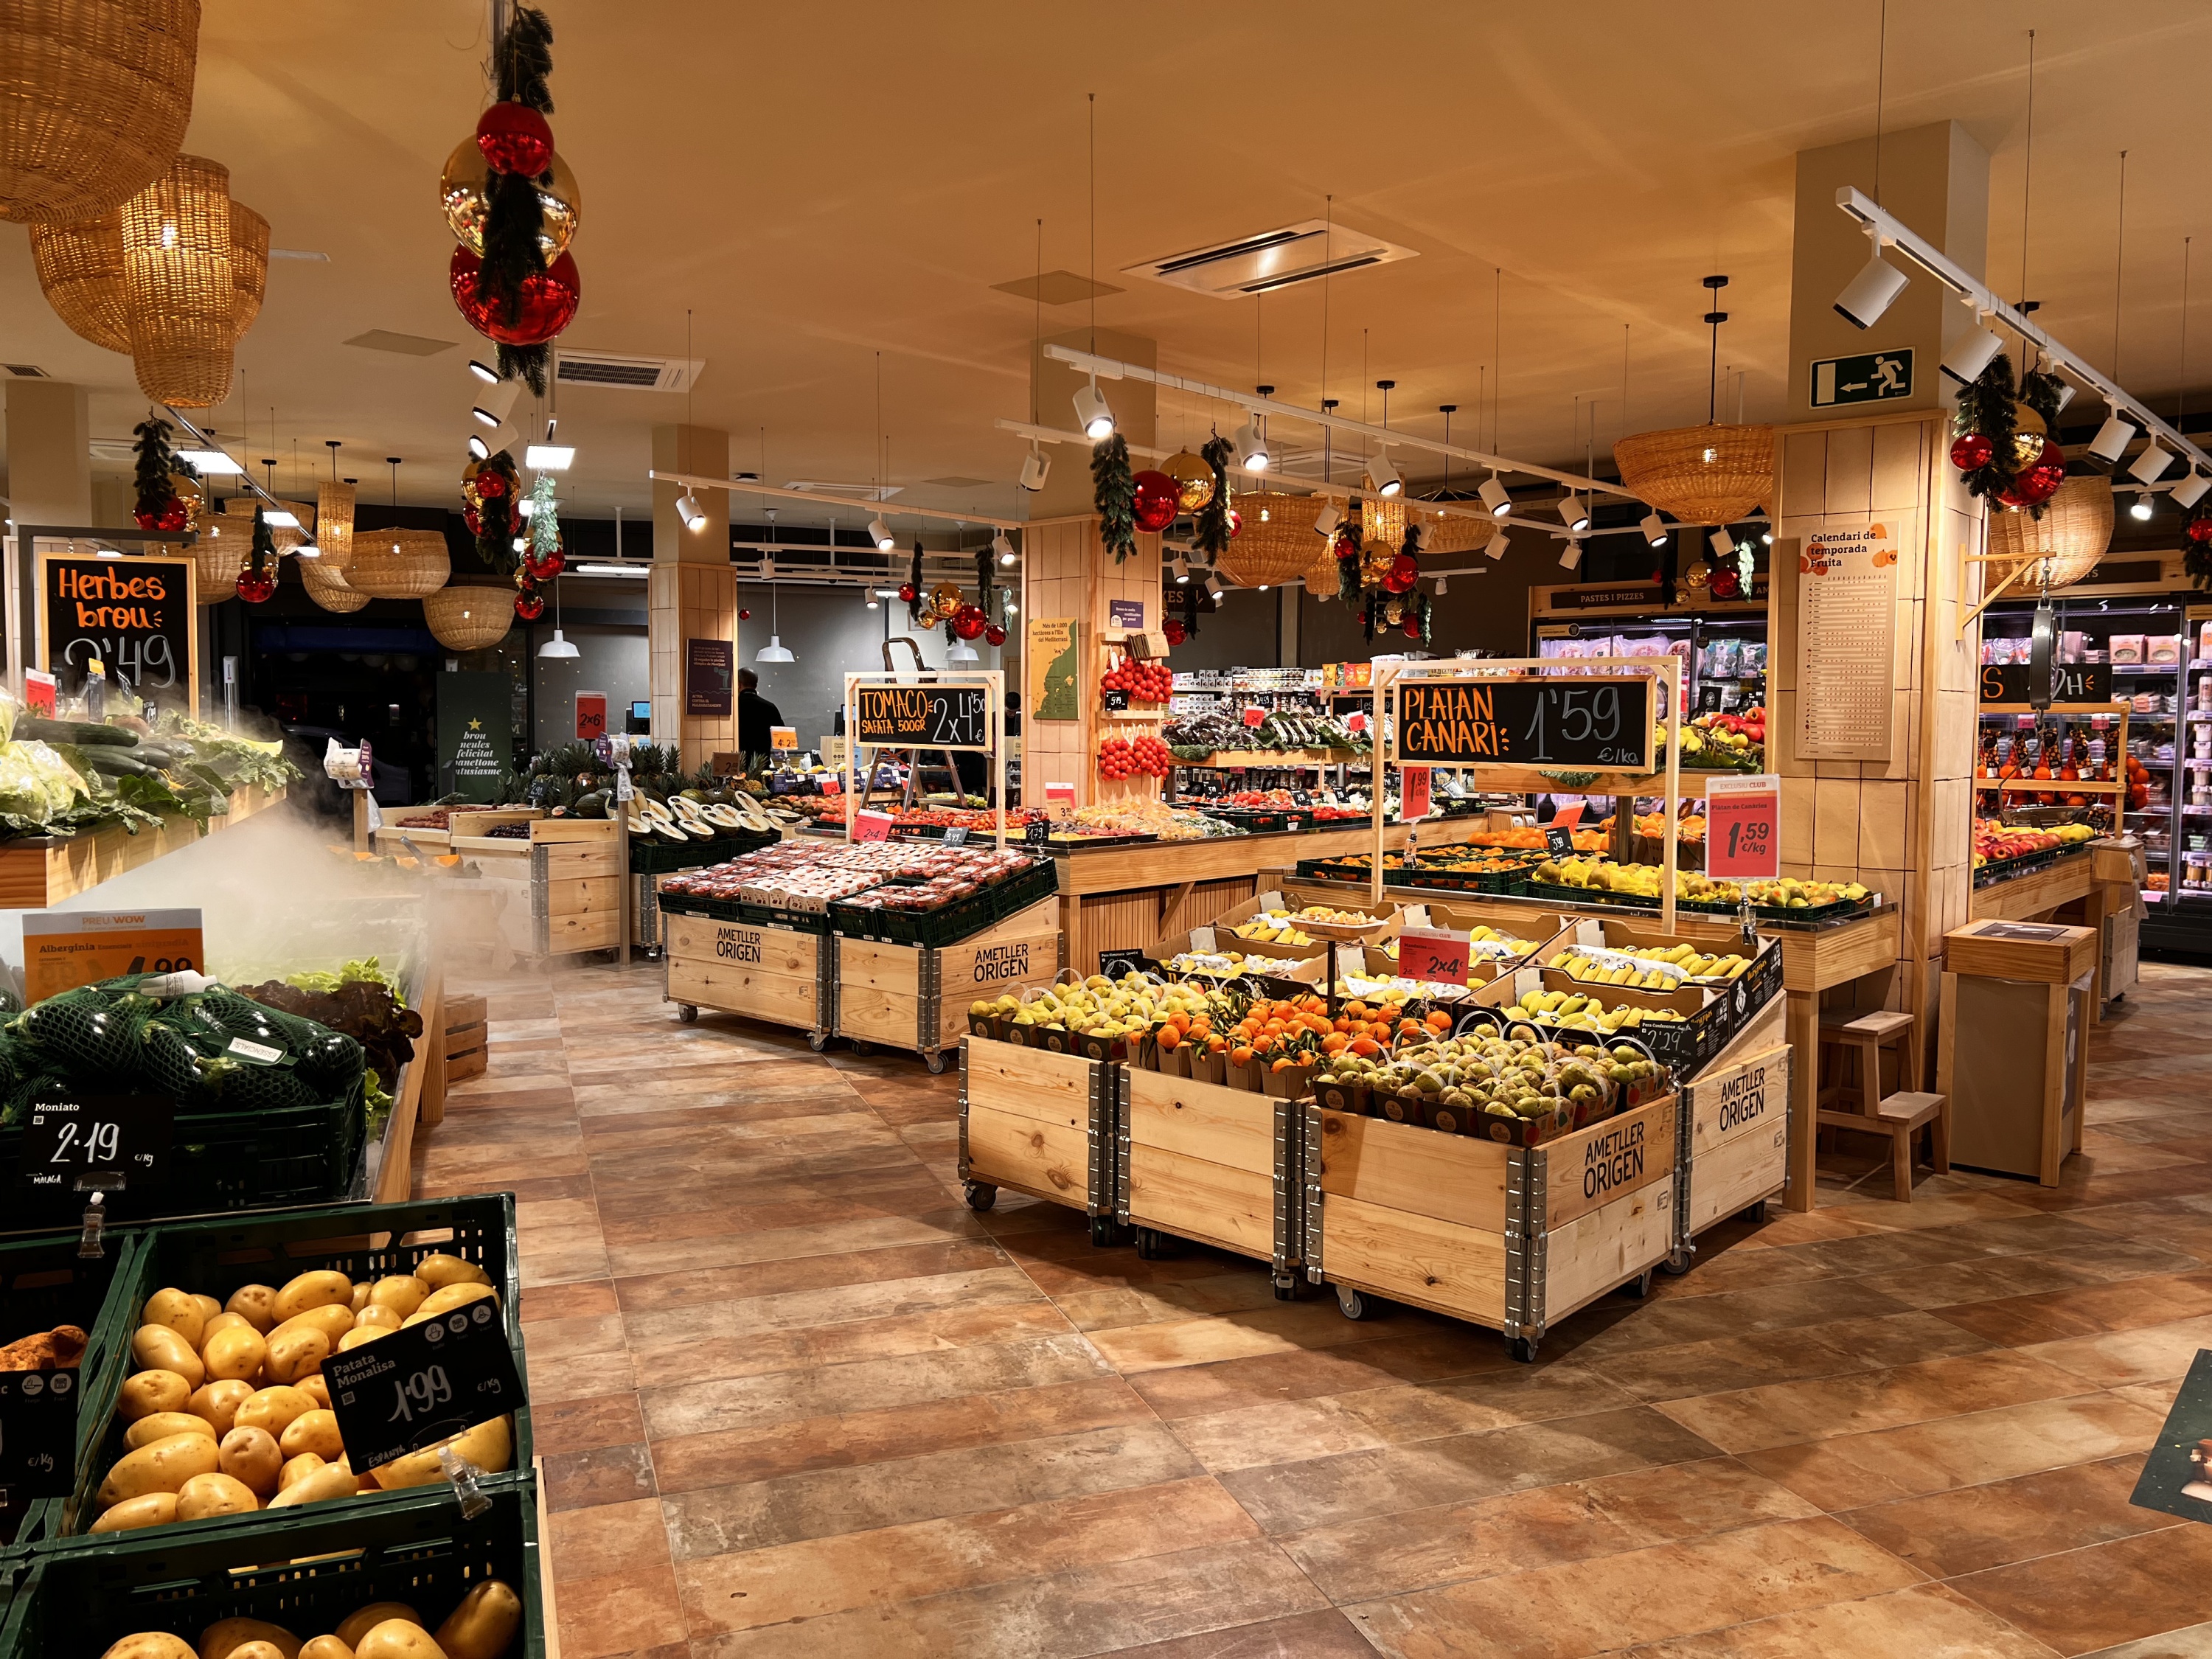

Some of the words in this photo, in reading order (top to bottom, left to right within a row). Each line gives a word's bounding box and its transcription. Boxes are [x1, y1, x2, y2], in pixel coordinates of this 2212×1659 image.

[1812, 532, 1860, 543] Calendari
[1863, 531, 1877, 540] de
[1810, 544, 1867, 556] temporada
[1811, 558, 1842, 568] Fruita
[59, 566, 166, 600] Herbes
[1580, 594, 1611, 603] PASTES
[1616, 592, 1644, 601] PIZZES
[76, 602, 154, 629] brou
[860, 689, 928, 720] TOMACO
[861, 720, 894, 734] SAFATA
[898, 719, 926, 731] 500GR
[1525, 686, 1621, 761] 1'59
[460, 740, 490, 748] neules
[463, 731, 487, 740] brou
[456, 749, 493, 759] felicitat
[455, 767, 502, 775] ntusiasme
[1728, 822, 1770, 858] 1,59
[1742, 842, 1767, 855] €/kg
[82, 916, 111, 926] PREU
[112, 915, 145, 925] WOW
[717, 927, 761, 945] AMETLLER
[39, 943, 95, 953] Alberginia
[717, 941, 761, 963] ORIGEN
[975, 944, 1029, 964] AMETLLER
[974, 957, 1029, 982] ORIGEN
[1720, 1067, 1765, 1103] AMETLLER
[35, 1103, 80, 1112] Moniato
[1719, 1088, 1764, 1132] ORIGEN
[1585, 1121, 1644, 1166] AMETLLER
[1584, 1144, 1644, 1199] ORIGEN
[333, 1354, 376, 1377] Patata
[336, 1359, 397, 1389] Monalisa
[368, 1444, 406, 1467] ESPANYA
